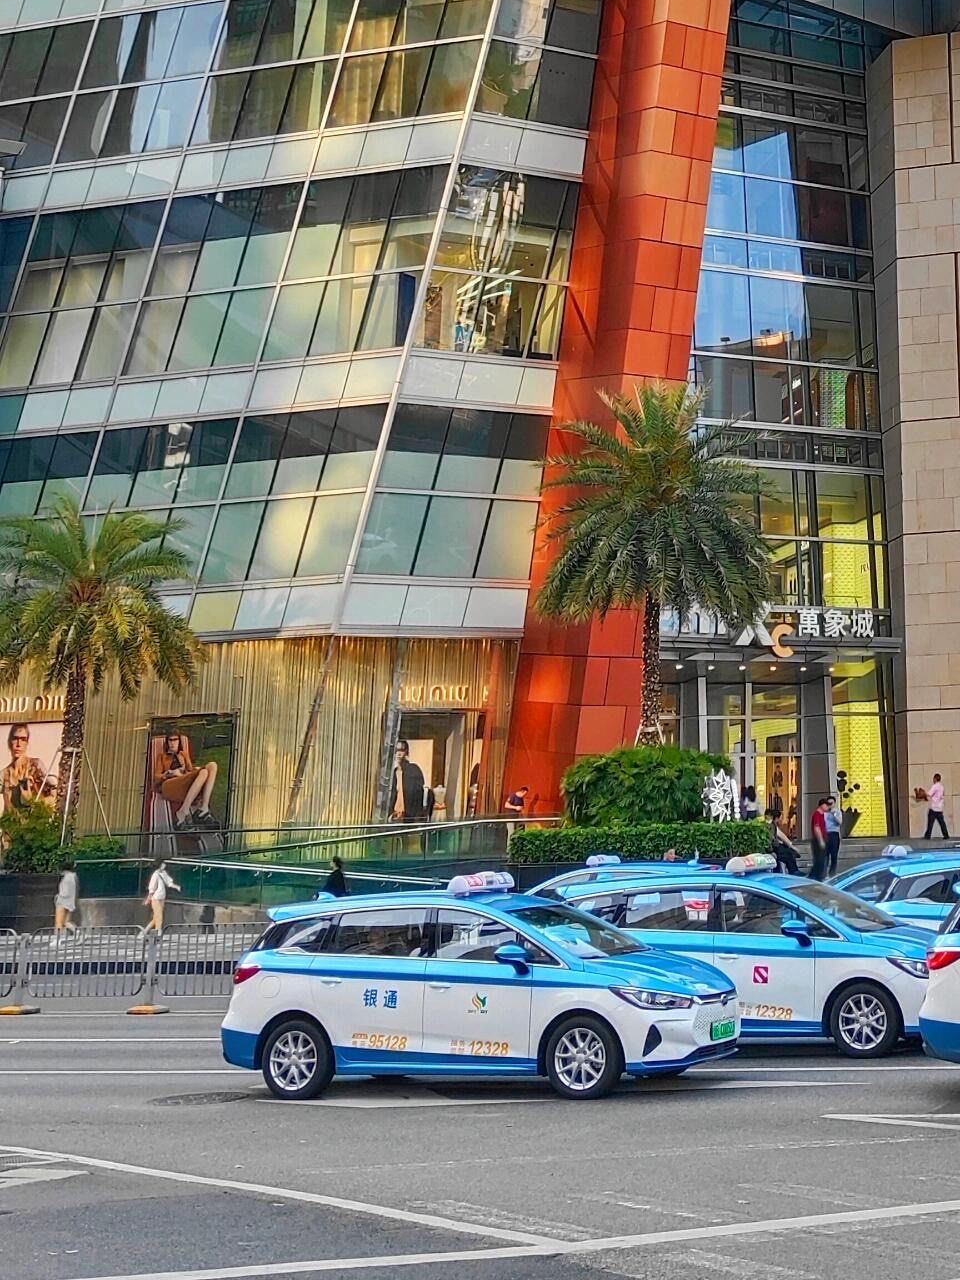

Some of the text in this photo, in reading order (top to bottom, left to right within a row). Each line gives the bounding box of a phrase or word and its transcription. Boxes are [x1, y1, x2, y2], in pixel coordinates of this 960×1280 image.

[797, 608, 875, 637] 萬象城
[363, 989, 398, 1009] 银通
[755, 1004, 793, 1019] 12328
[368, 1034, 407, 1050] 95128
[468, 1040, 510, 1056] 12328
